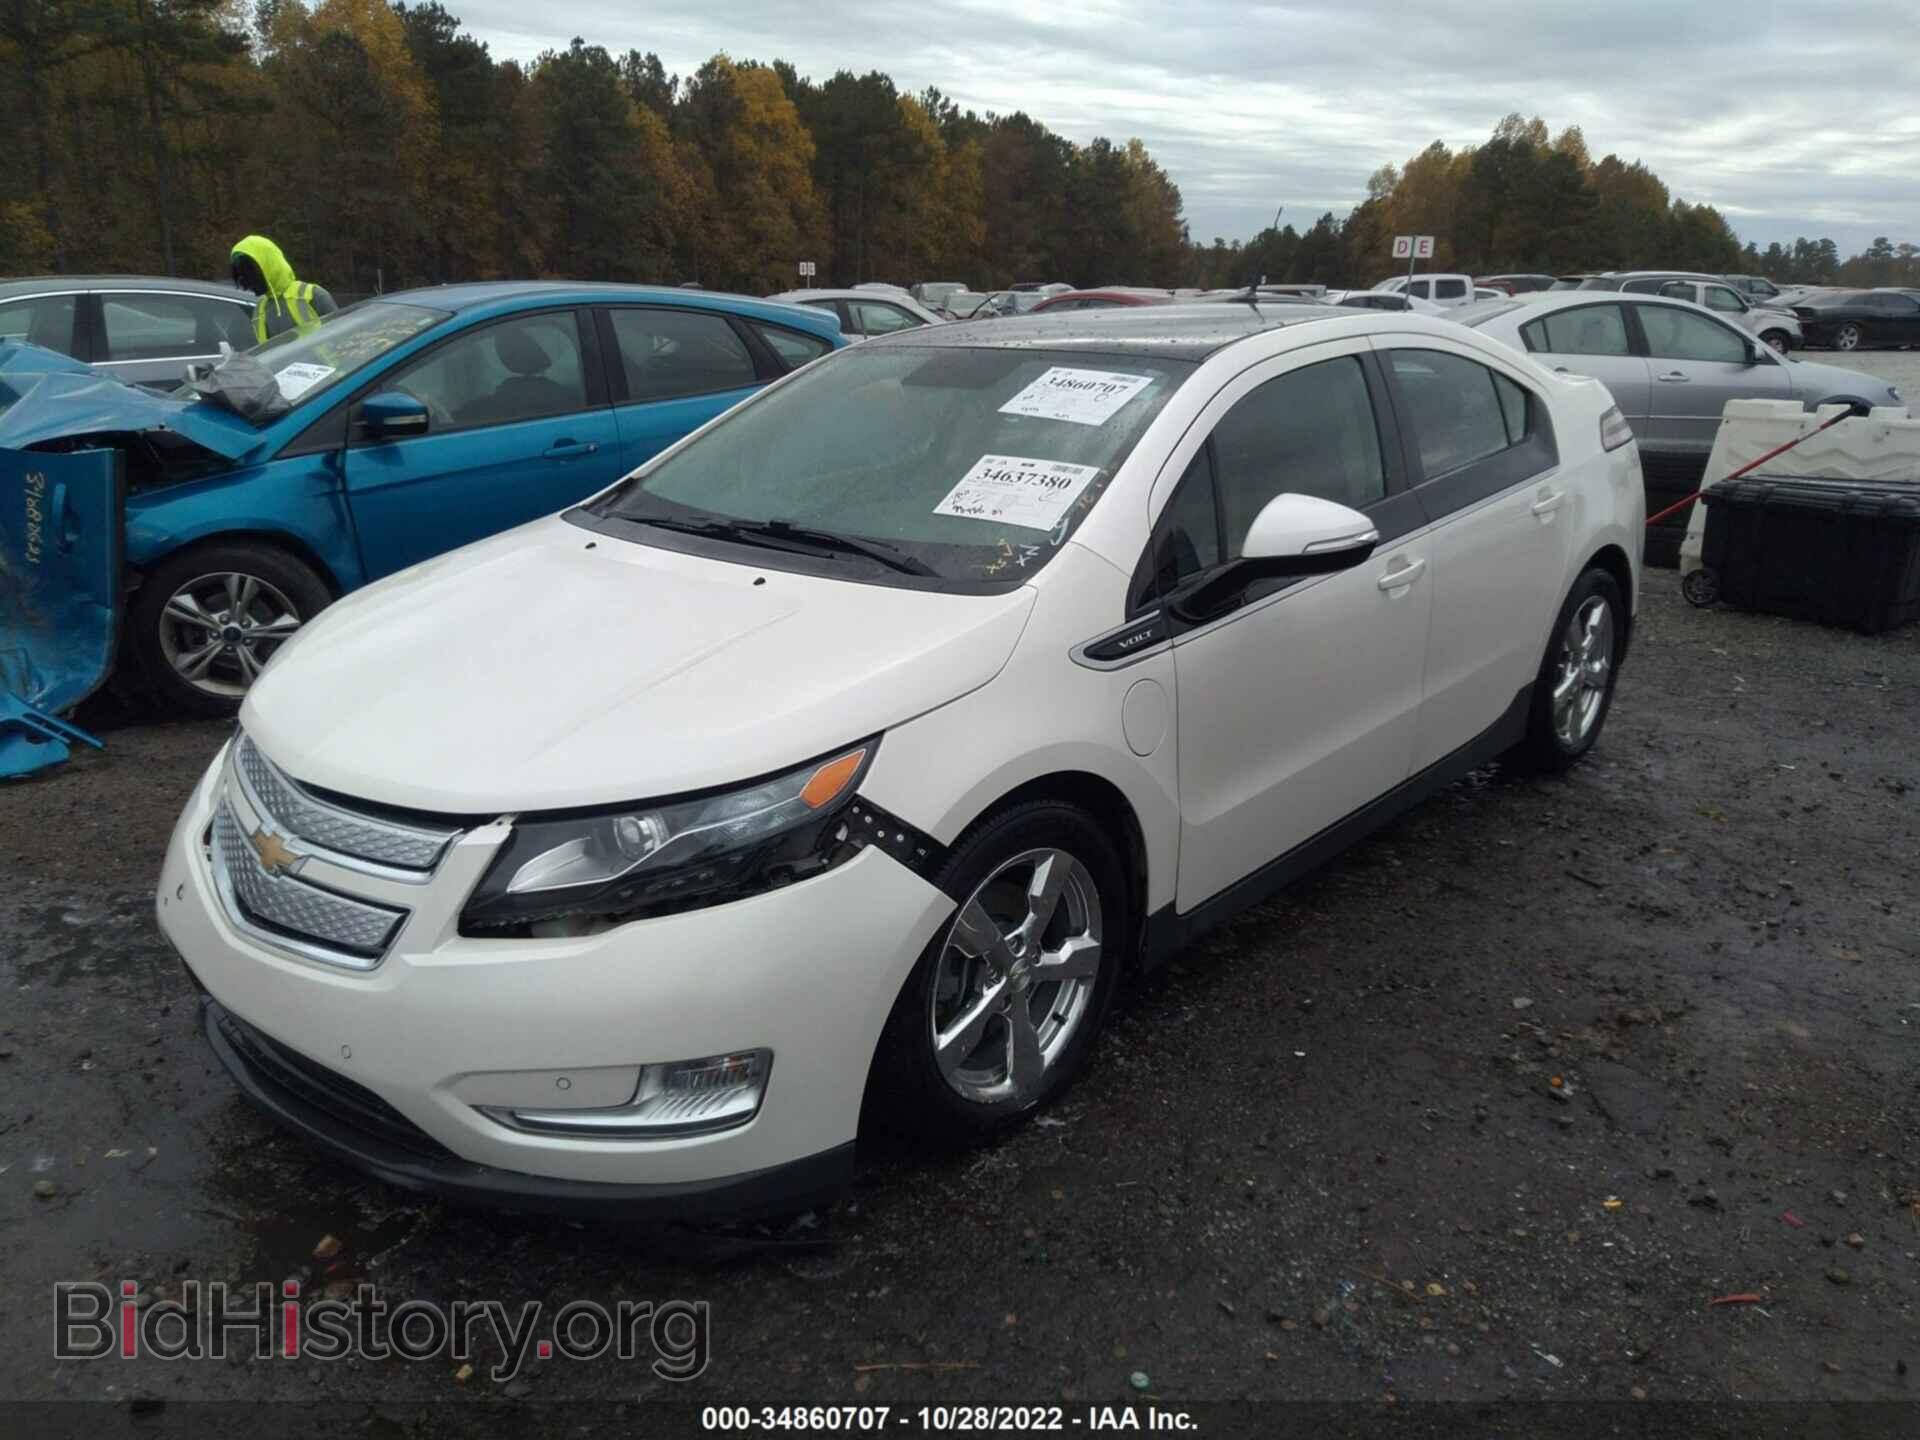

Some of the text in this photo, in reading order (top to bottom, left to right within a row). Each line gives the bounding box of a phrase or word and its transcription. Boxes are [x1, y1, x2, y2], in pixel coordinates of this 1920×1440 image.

[1397, 240, 1429, 255] D E
[1043, 376, 1129, 395] 34860707
[975, 468, 1072, 489] 34637380
[1118, 629, 1153, 648] VOLT
